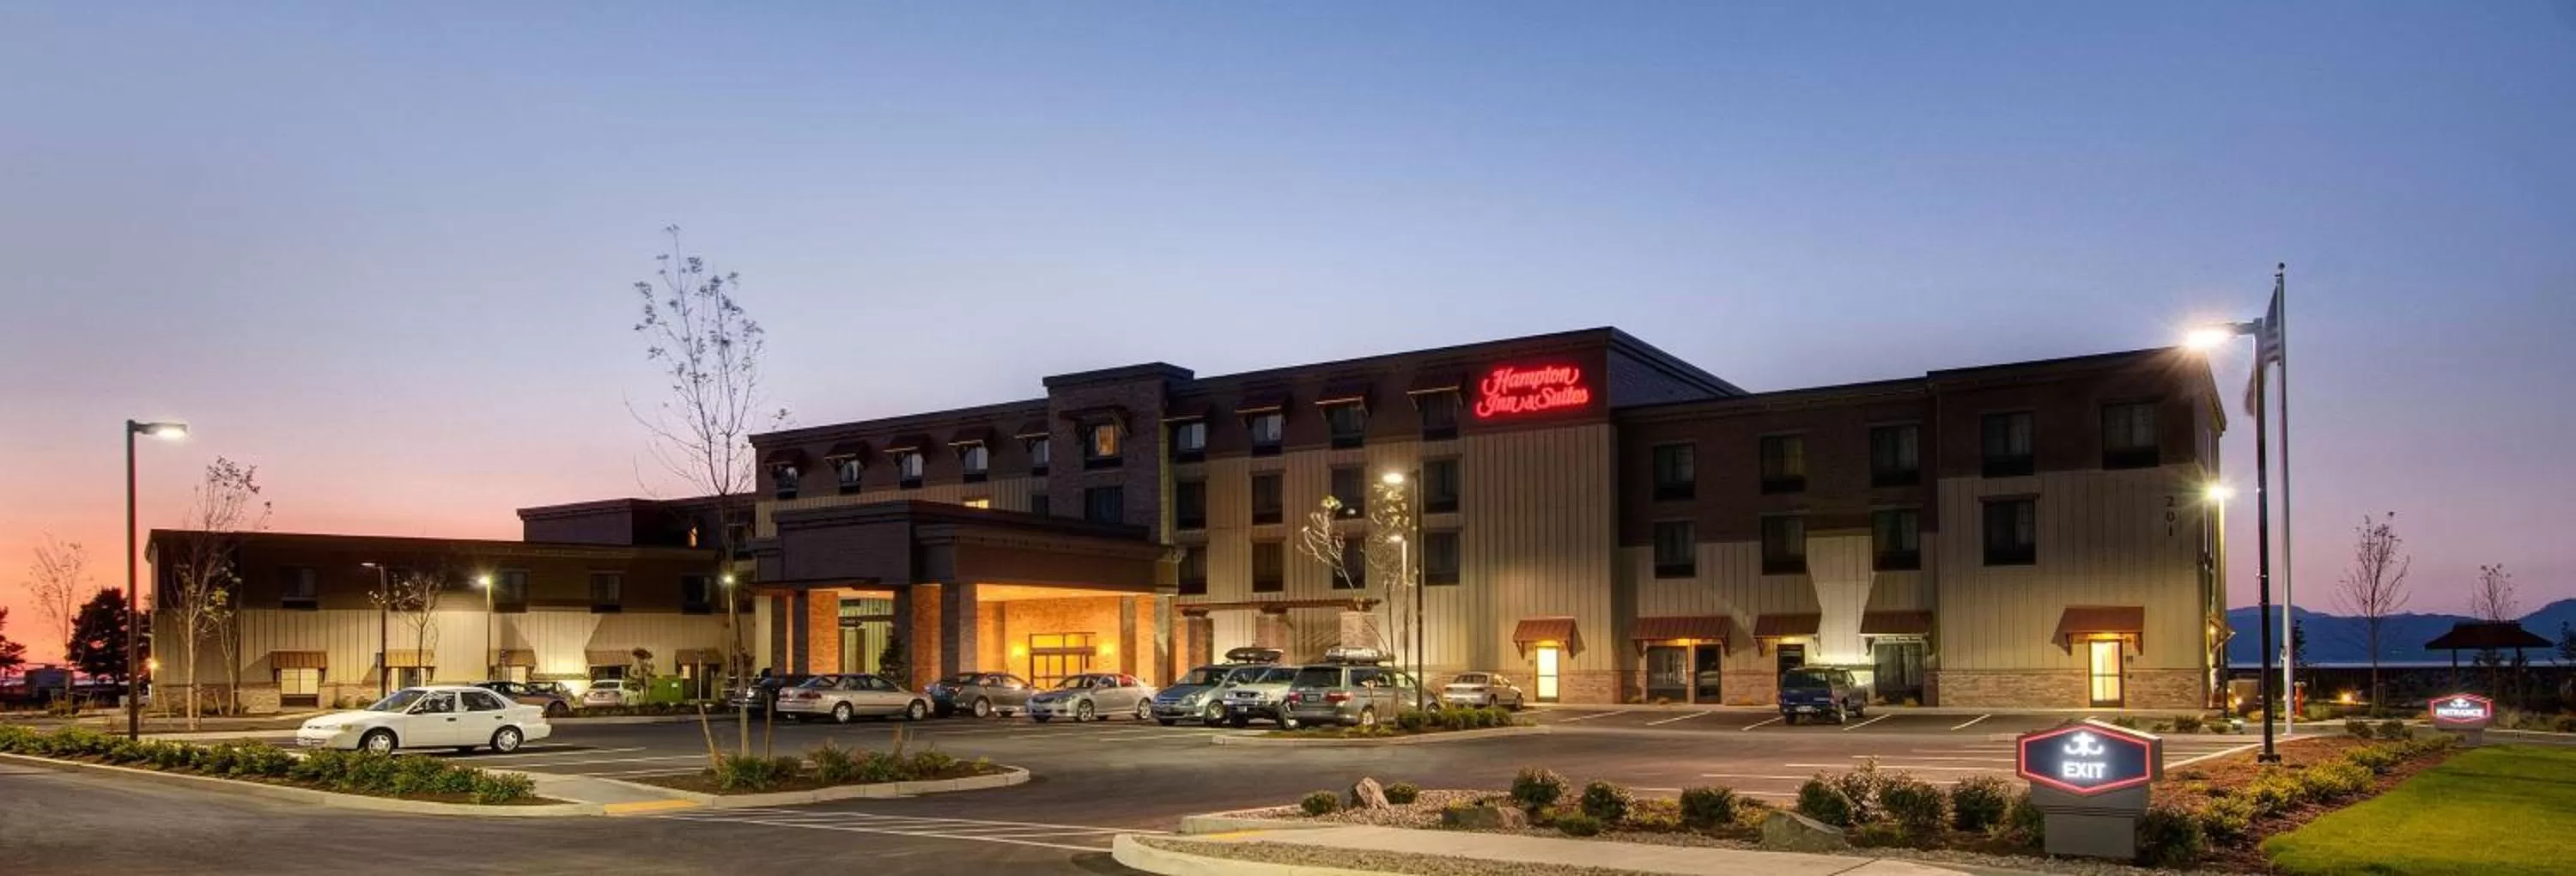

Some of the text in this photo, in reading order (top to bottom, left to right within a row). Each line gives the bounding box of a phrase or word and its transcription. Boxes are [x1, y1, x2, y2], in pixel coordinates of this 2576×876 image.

[1481, 365, 1580, 395] Hampton
[1476, 393, 1524, 417] Inn
[1534, 386, 1589, 410] Suites
[2164, 495, 2176, 537] 201
[2063, 762, 2106, 778] EXIT
